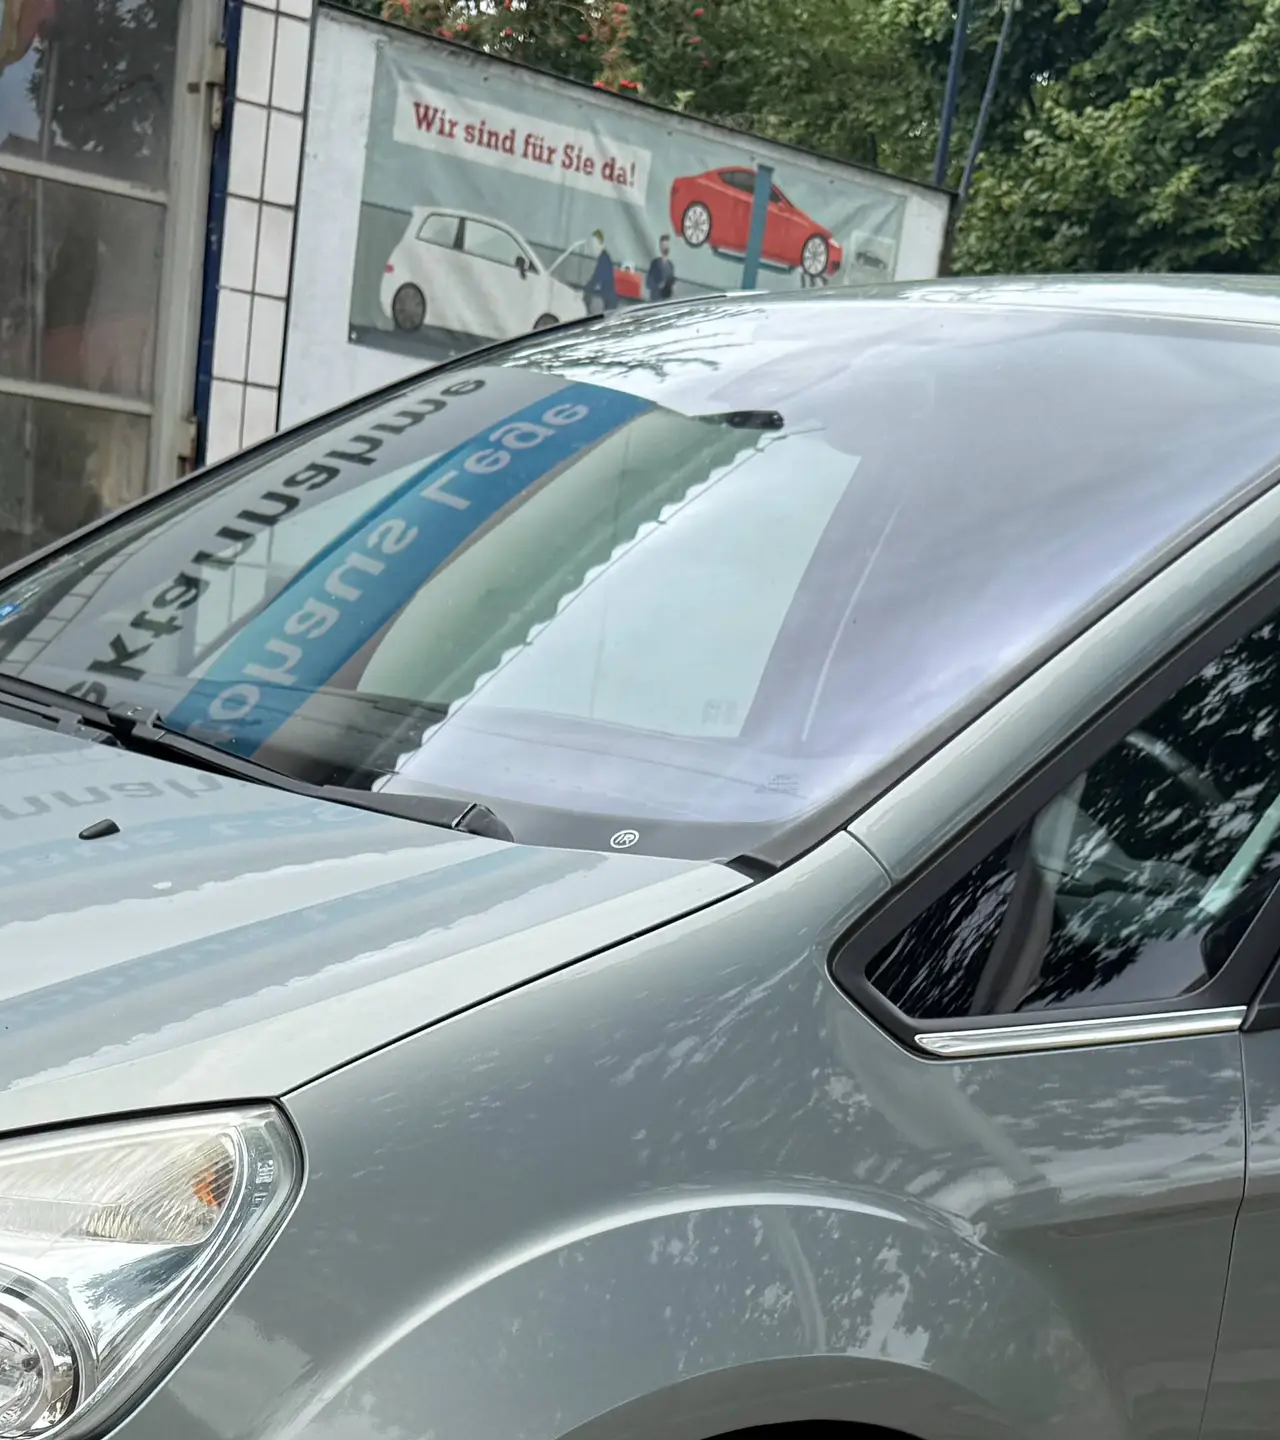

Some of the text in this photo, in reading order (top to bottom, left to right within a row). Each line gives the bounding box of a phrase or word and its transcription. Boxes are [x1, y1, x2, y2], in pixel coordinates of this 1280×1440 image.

[413, 101, 637, 188] Wir sind für Sie da!
[613, 832, 638, 846] IR
